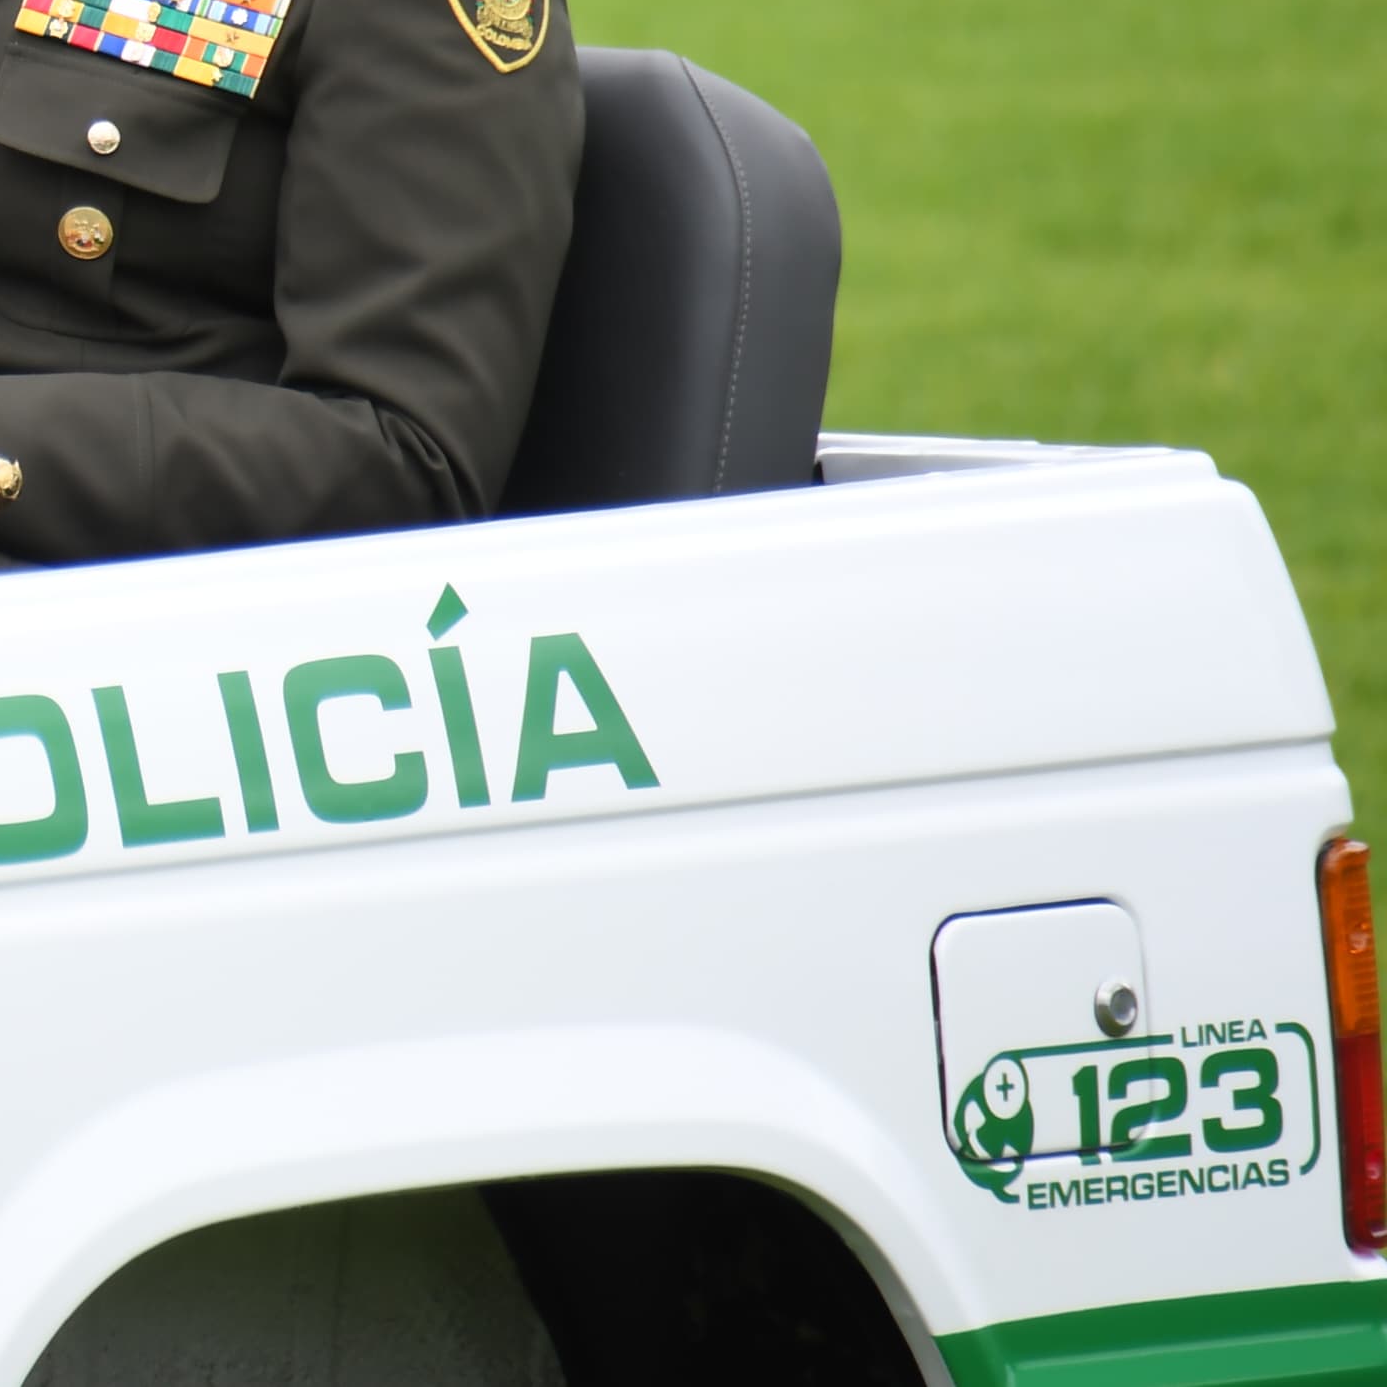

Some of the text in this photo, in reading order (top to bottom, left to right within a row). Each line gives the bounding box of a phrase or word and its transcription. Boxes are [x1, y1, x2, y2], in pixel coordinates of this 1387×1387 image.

[1180, 1018, 1268, 1048] LINEA
[1072, 1047, 1283, 1166] 123
[1027, 1158, 1290, 1210] EMERGENCIAS
